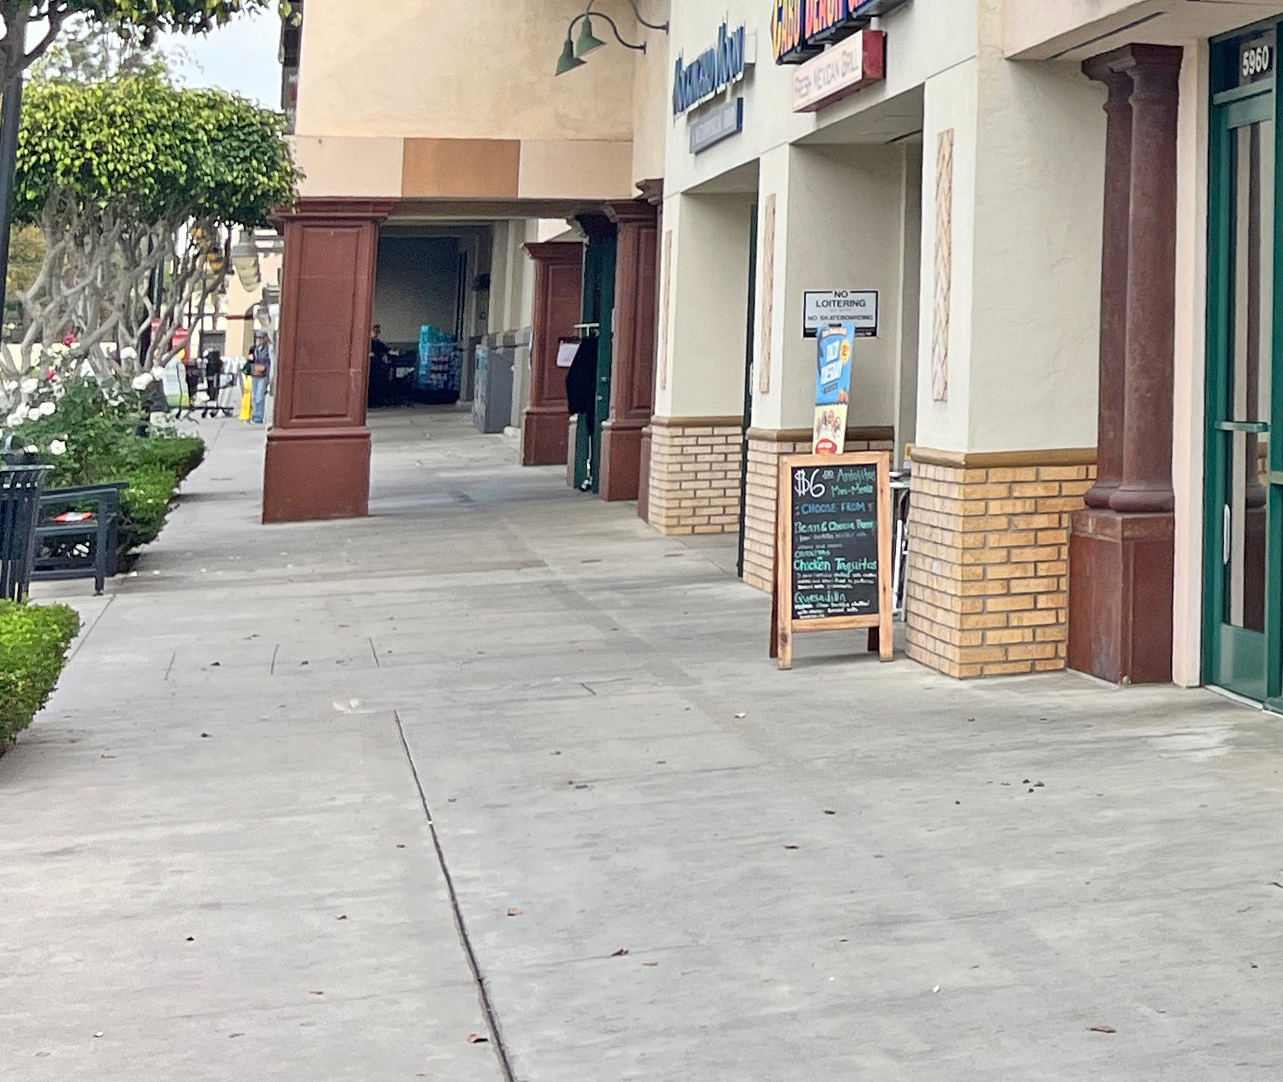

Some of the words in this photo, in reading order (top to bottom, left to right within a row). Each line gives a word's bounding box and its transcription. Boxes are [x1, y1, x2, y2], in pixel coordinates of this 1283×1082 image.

[1242, 45, 1270, 77] 5960
[834, 290, 848, 298] NO
[794, 469, 826, 497] $6
[801, 503, 836, 514] CHOOSE
[841, 502, 866, 512] FROM
[794, 522, 820, 533] Bean
[794, 558, 831, 571] Chicken
[834, 558, 877, 576] Taquitos
[794, 591, 846, 604] Quesadilla
